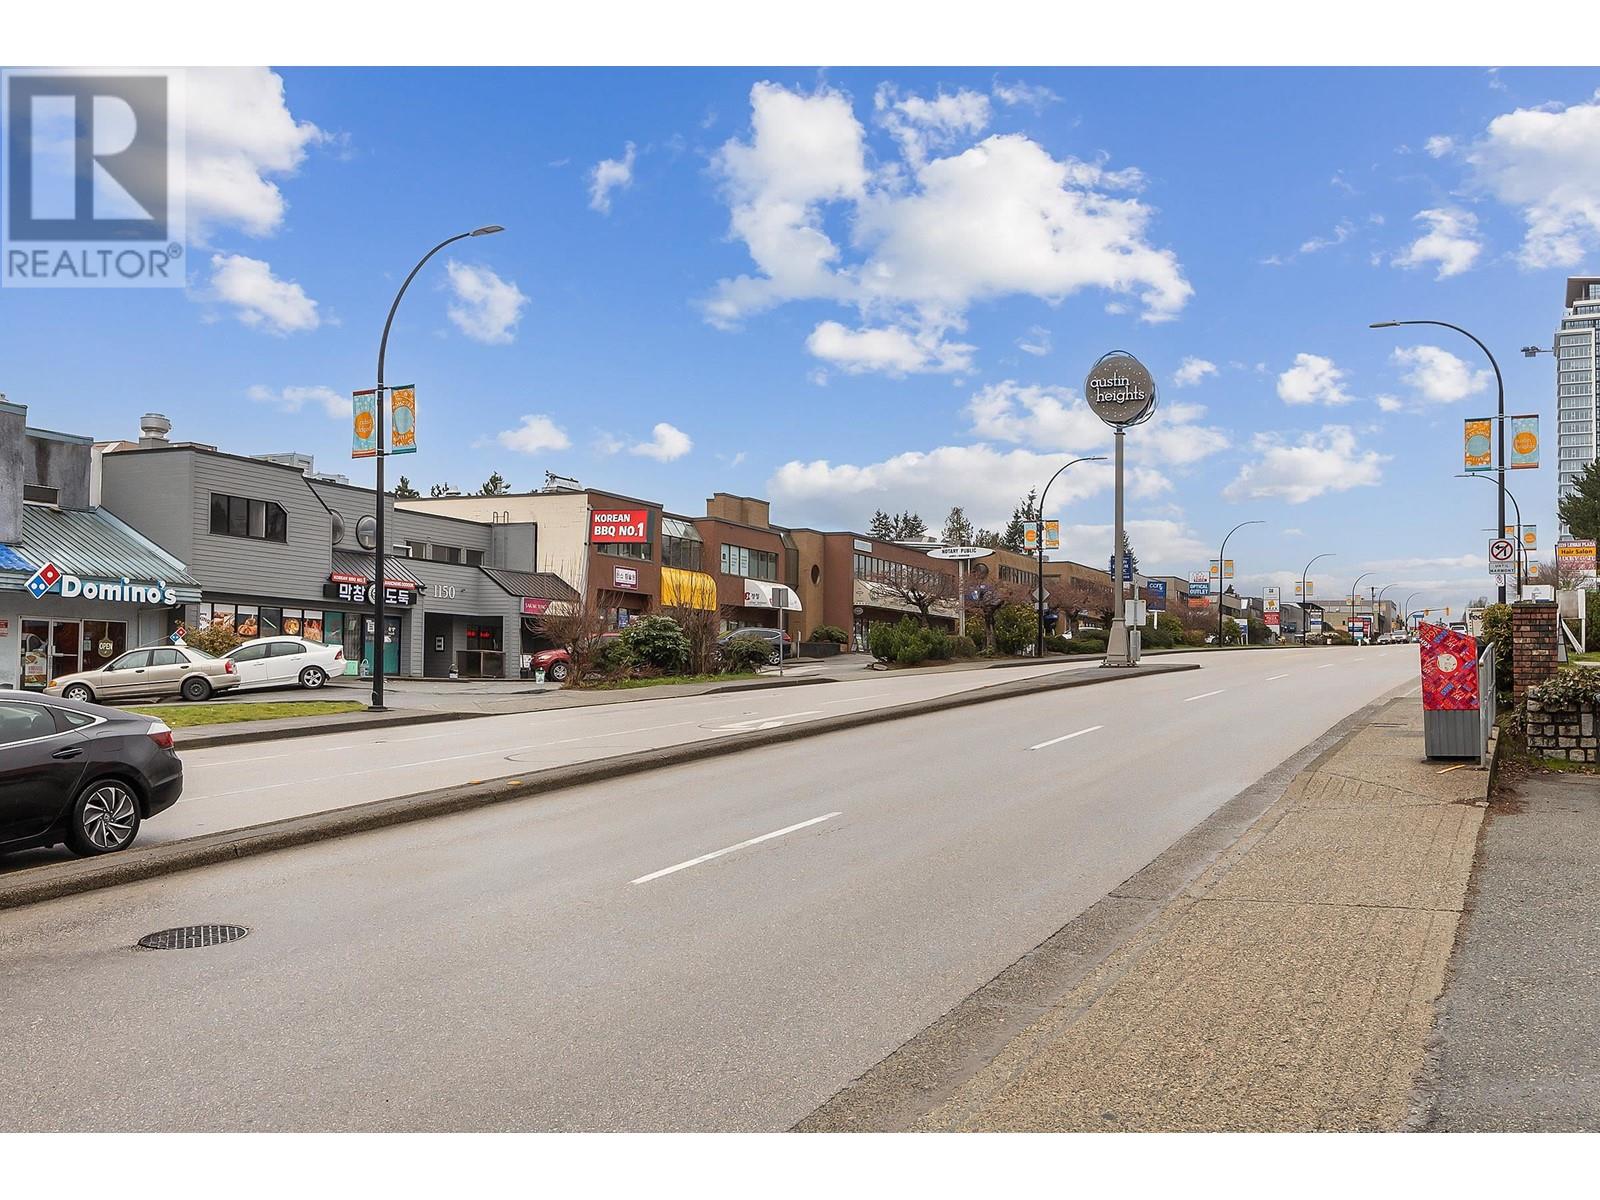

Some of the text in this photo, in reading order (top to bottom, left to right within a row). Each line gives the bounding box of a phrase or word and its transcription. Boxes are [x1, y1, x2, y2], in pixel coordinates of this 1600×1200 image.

[1090, 372, 1130, 388] austin
[1096, 385, 1145, 403] heights
[594, 513, 631, 523] KOREAN
[594, 522, 644, 537] BBQ NO.1
[61, 575, 177, 605] Domino's
[339, 583, 410, 605] 막창 도둑
[432, 584, 456, 599] 1150
[99, 642, 113, 651] OPEN
